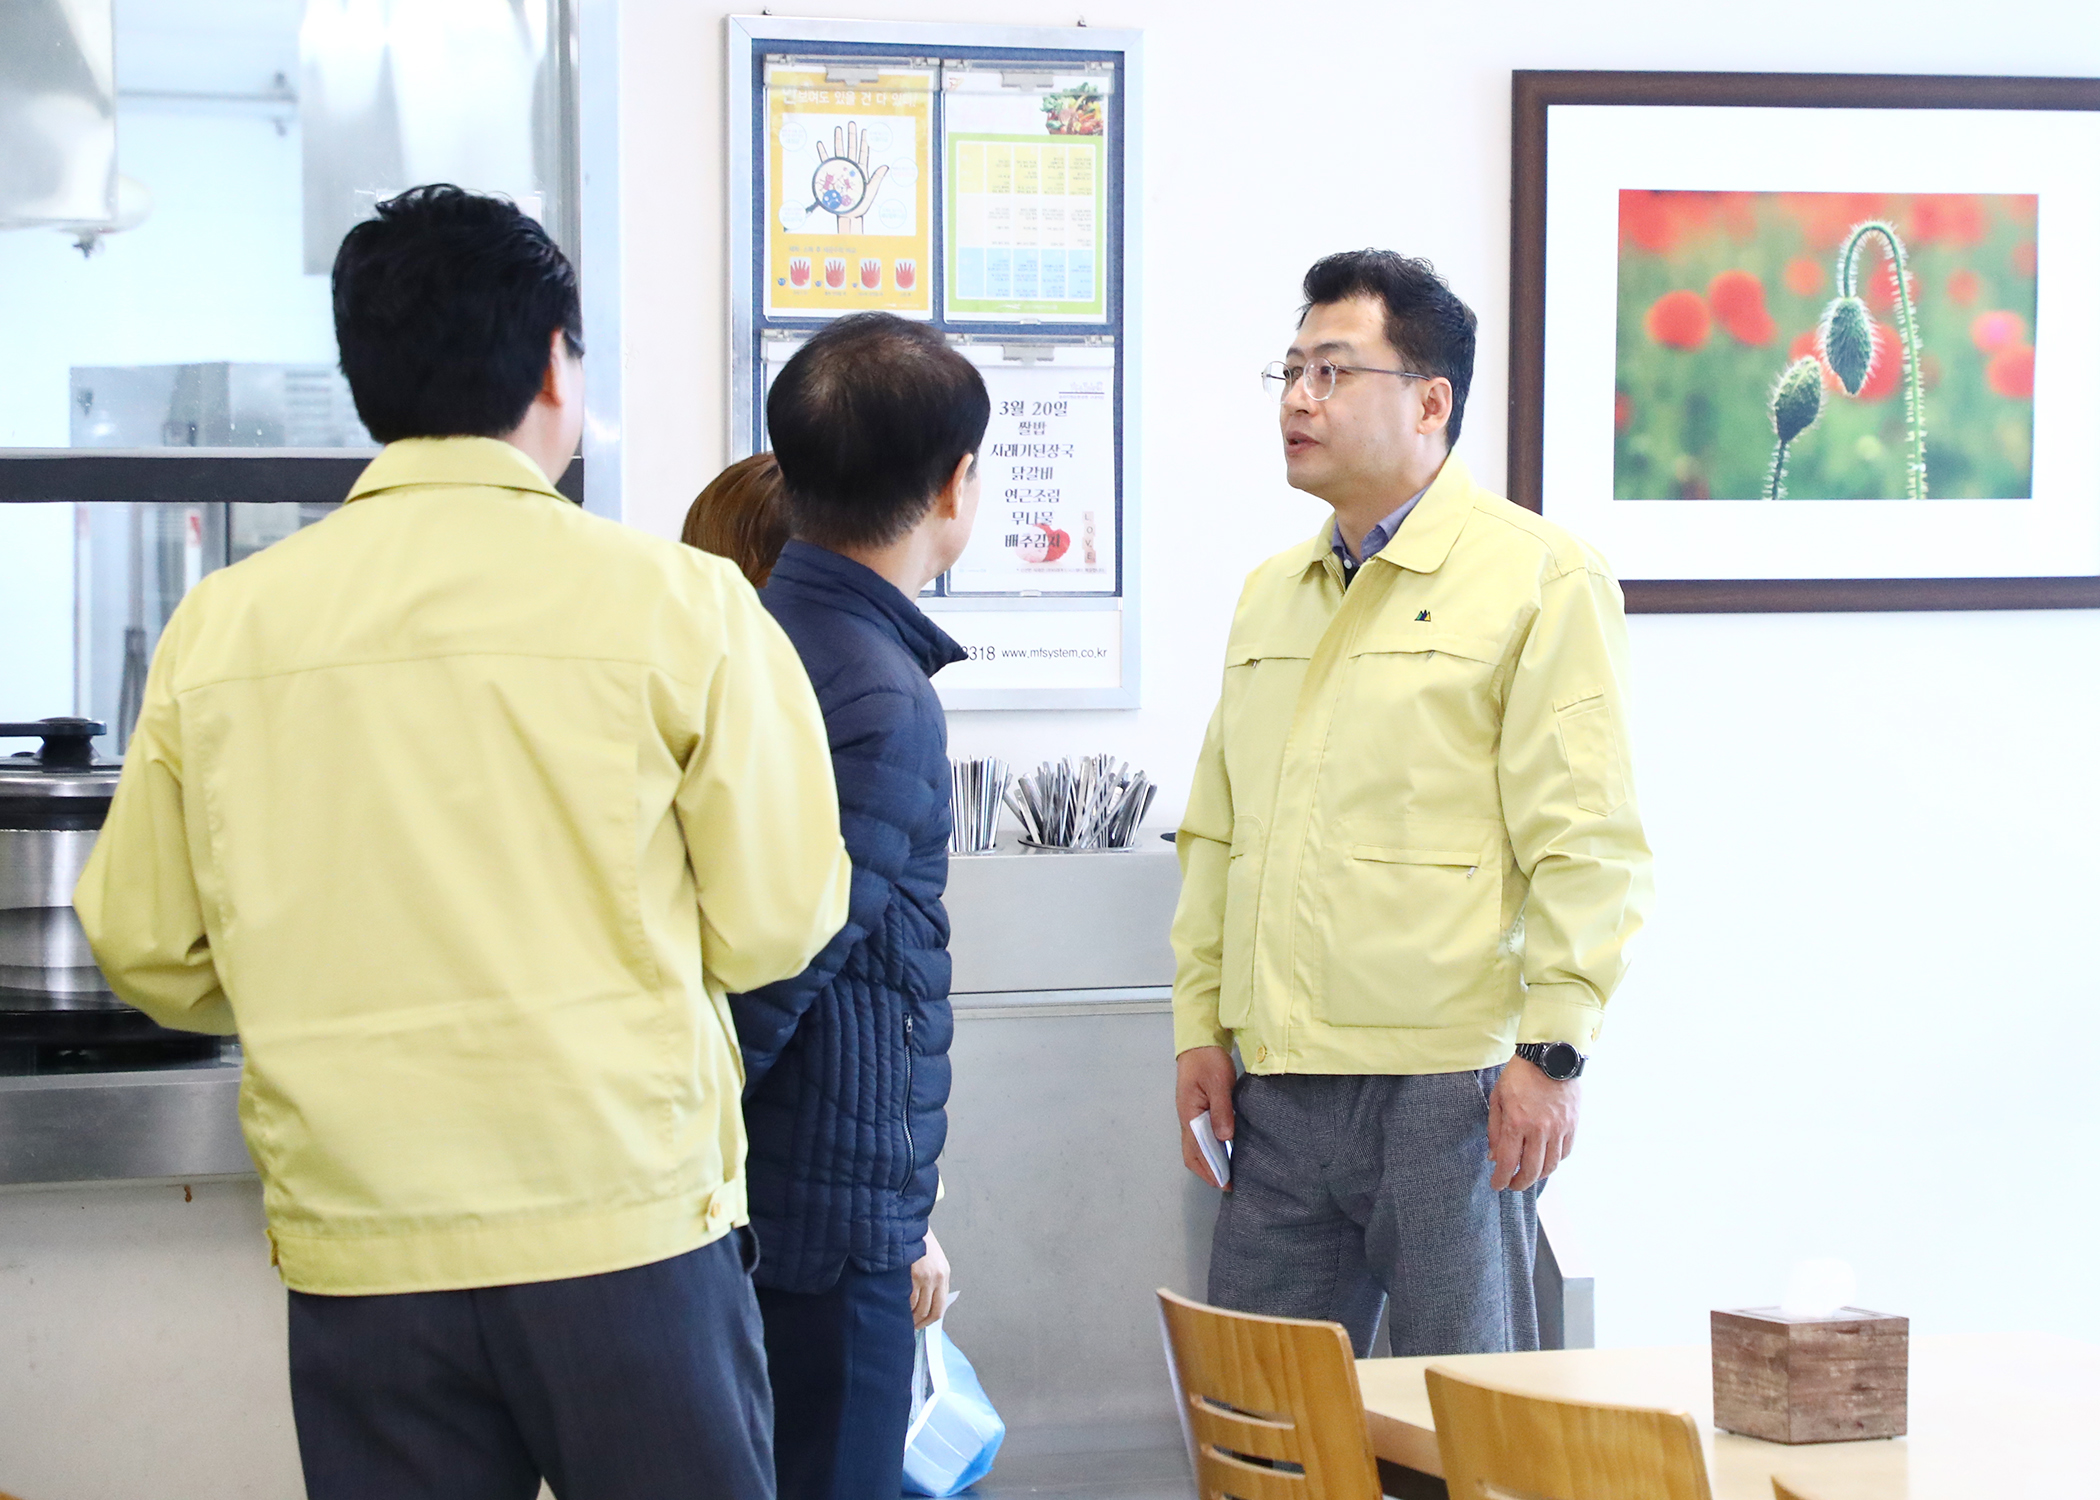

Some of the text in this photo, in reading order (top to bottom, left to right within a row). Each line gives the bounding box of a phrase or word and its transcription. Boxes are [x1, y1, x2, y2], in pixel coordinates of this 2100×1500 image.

[834, 91, 856, 106] 있을
[860, 91, 872, 106] 건
[876, 92, 887, 106] 다
[999, 400, 1068, 417] 3월 20일
[1018, 421, 1047, 436] 쌀밥
[990, 443, 1075, 459] 시래기된장국
[1011, 466, 1053, 481] 닭갈비
[1004, 488, 1061, 504] 연근조림
[1011, 511, 1054, 526] 무나물
[1004, 533, 1061, 548] 배추김치
[1084, 513, 1095, 560] LOVE
[1001, 647, 1108, 660] www.mfsystem.co.kr
